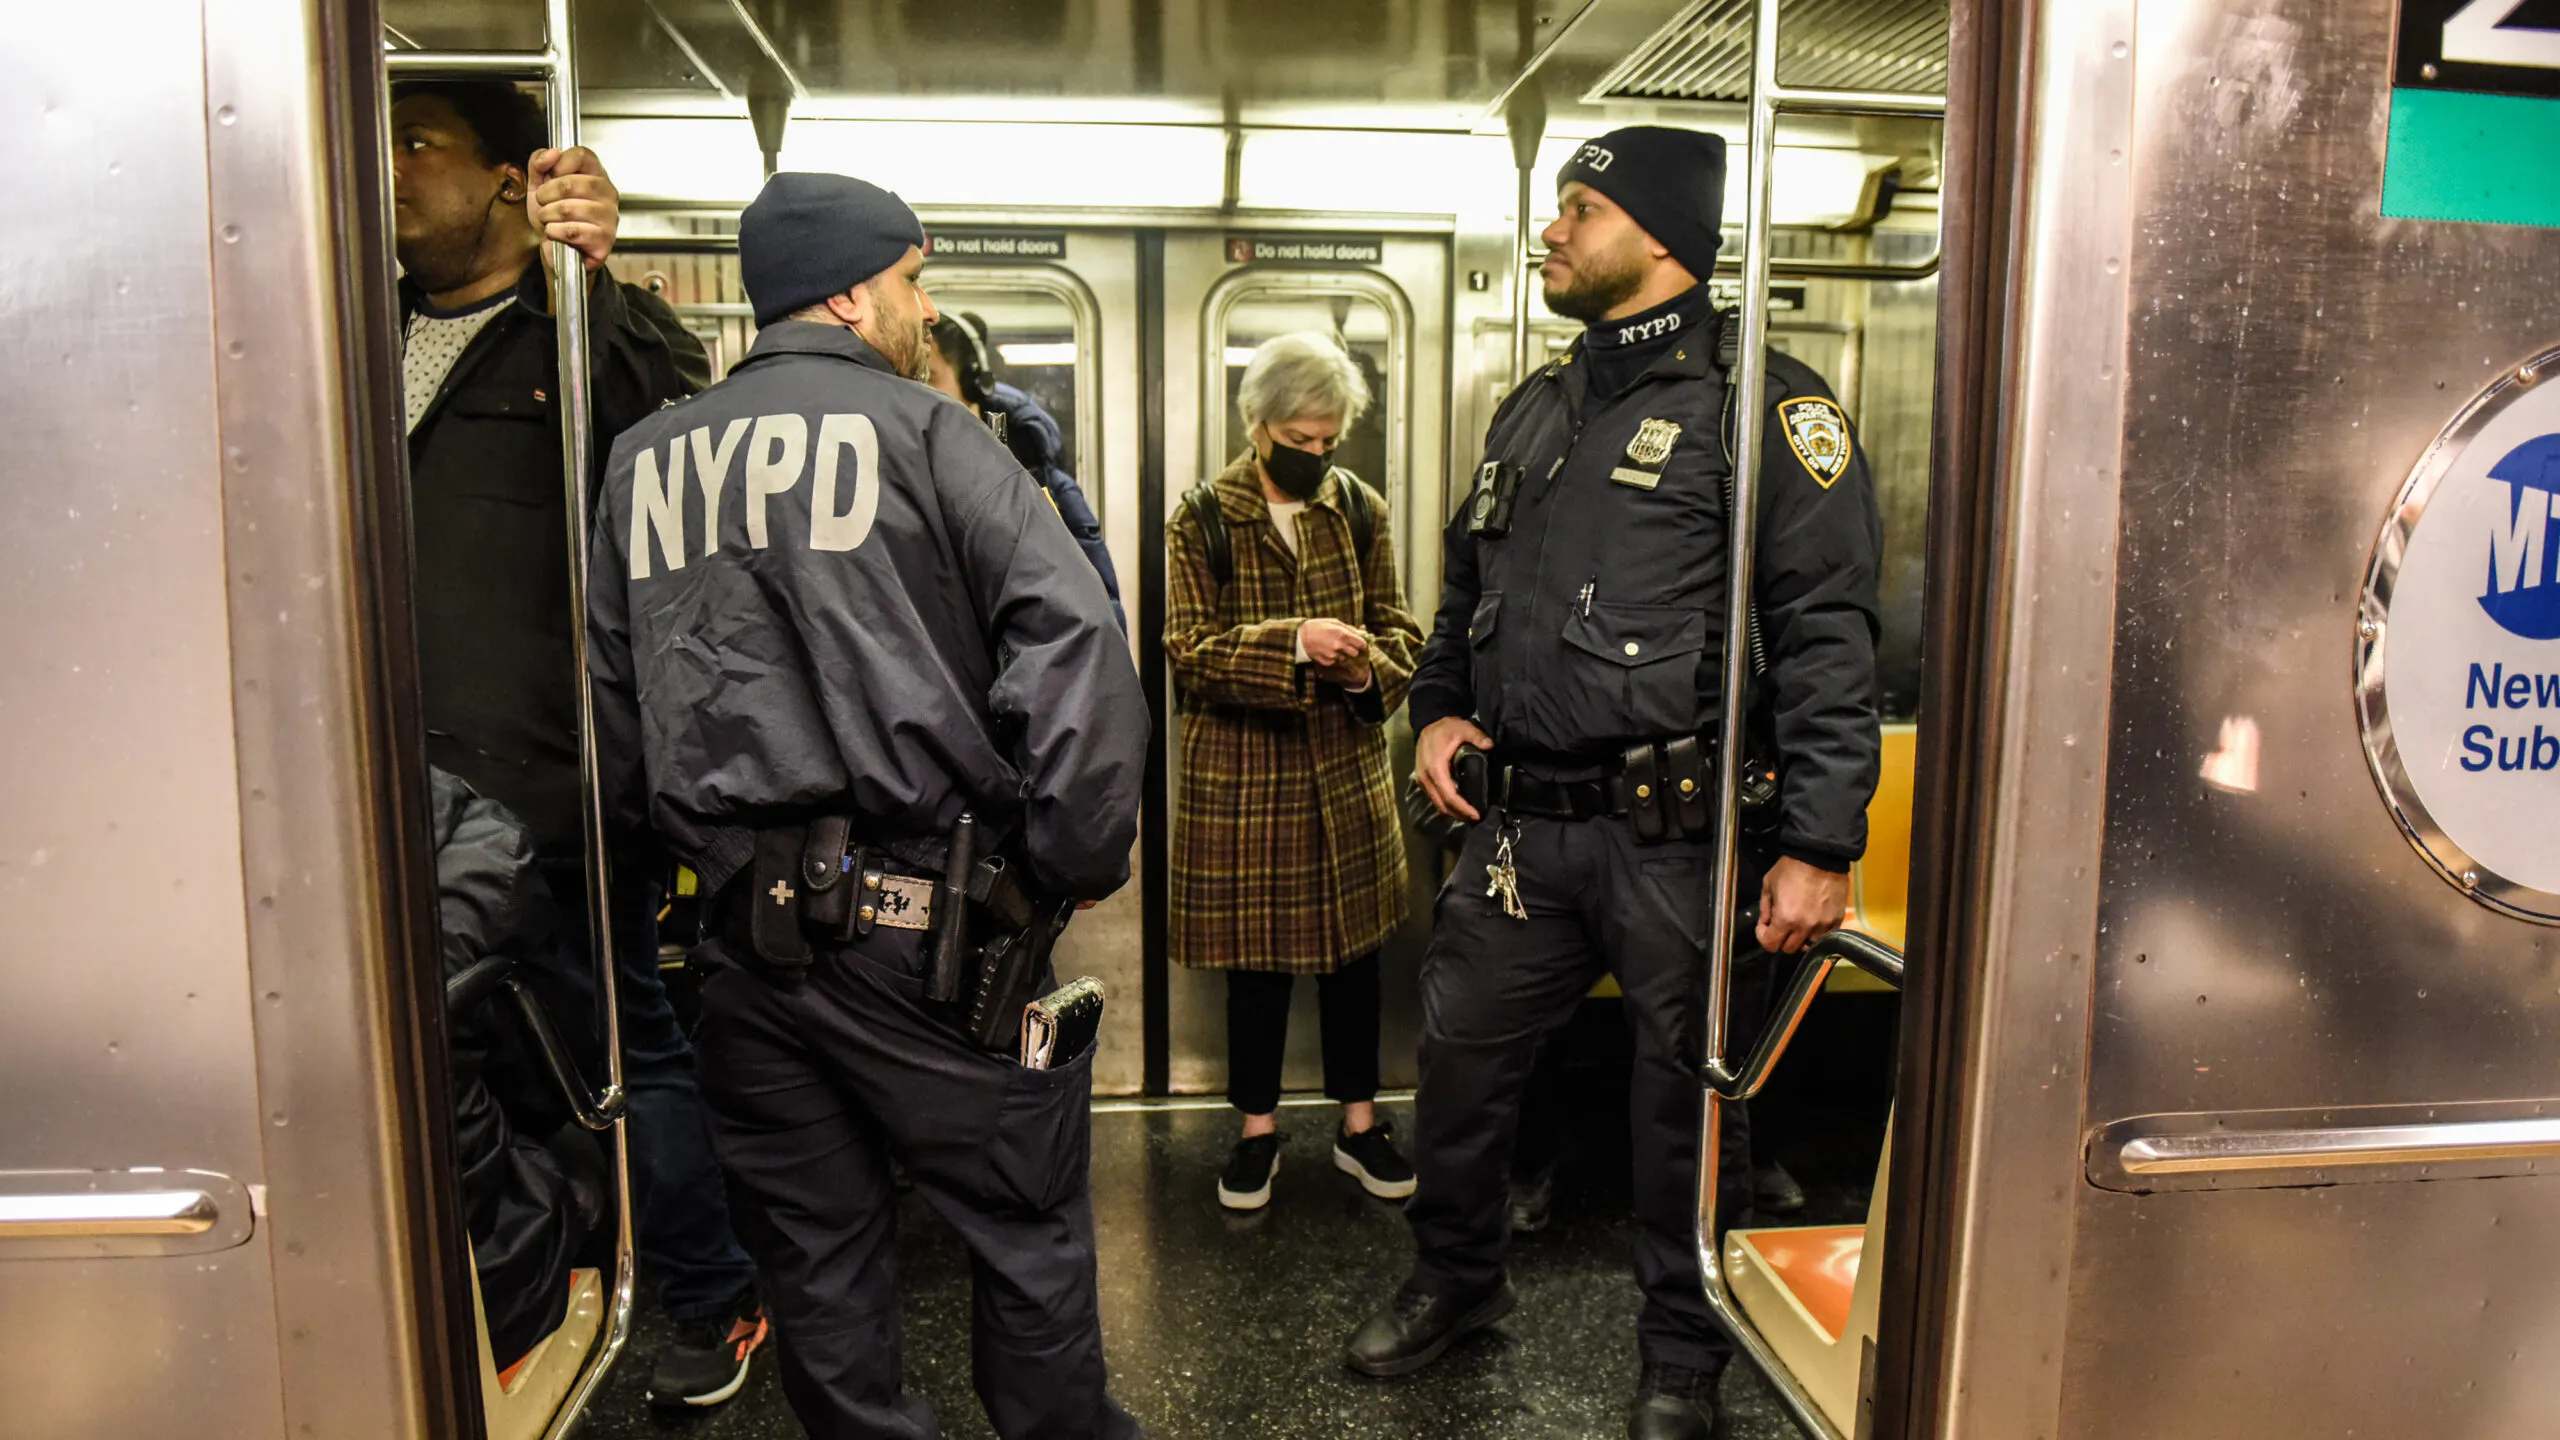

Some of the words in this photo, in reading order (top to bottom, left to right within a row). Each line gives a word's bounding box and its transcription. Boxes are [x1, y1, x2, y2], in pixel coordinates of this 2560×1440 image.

[933, 236, 955, 252] Do
[957, 238, 981, 253] not
[983, 237, 1015, 253] hold
[1017, 239, 1059, 254] doors
[1255, 243, 1274, 258] Do
[1278, 244, 1301, 259] not
[1303, 244, 1334, 259] hold
[1336, 244, 1377, 260] doors
[1473, 272, 1484, 290] 1
[1618, 312, 1681, 345] NYPD
[629, 413, 880, 580] NYPD
